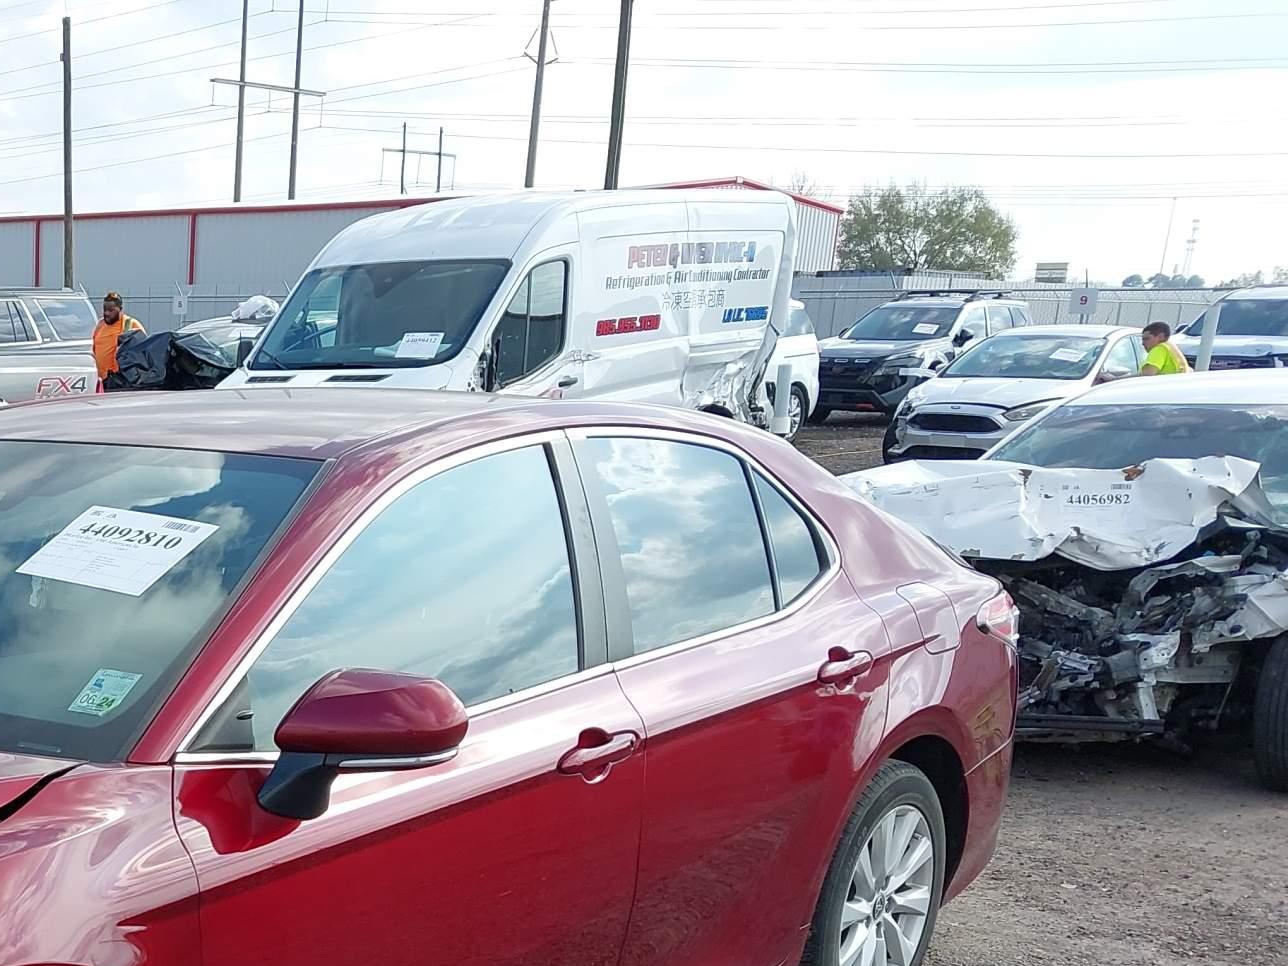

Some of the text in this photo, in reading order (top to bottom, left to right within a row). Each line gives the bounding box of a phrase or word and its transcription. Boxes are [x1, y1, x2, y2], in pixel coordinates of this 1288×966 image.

[605, 273, 665, 291] Refrigeration
[674, 271, 688, 284] Air
[733, 267, 771, 281] Contractor
[1079, 295, 1088, 305] 9
[37, 376, 87, 393] FX4
[1066, 494, 1131, 505] 44056982
[79, 522, 182, 550] 44092810
